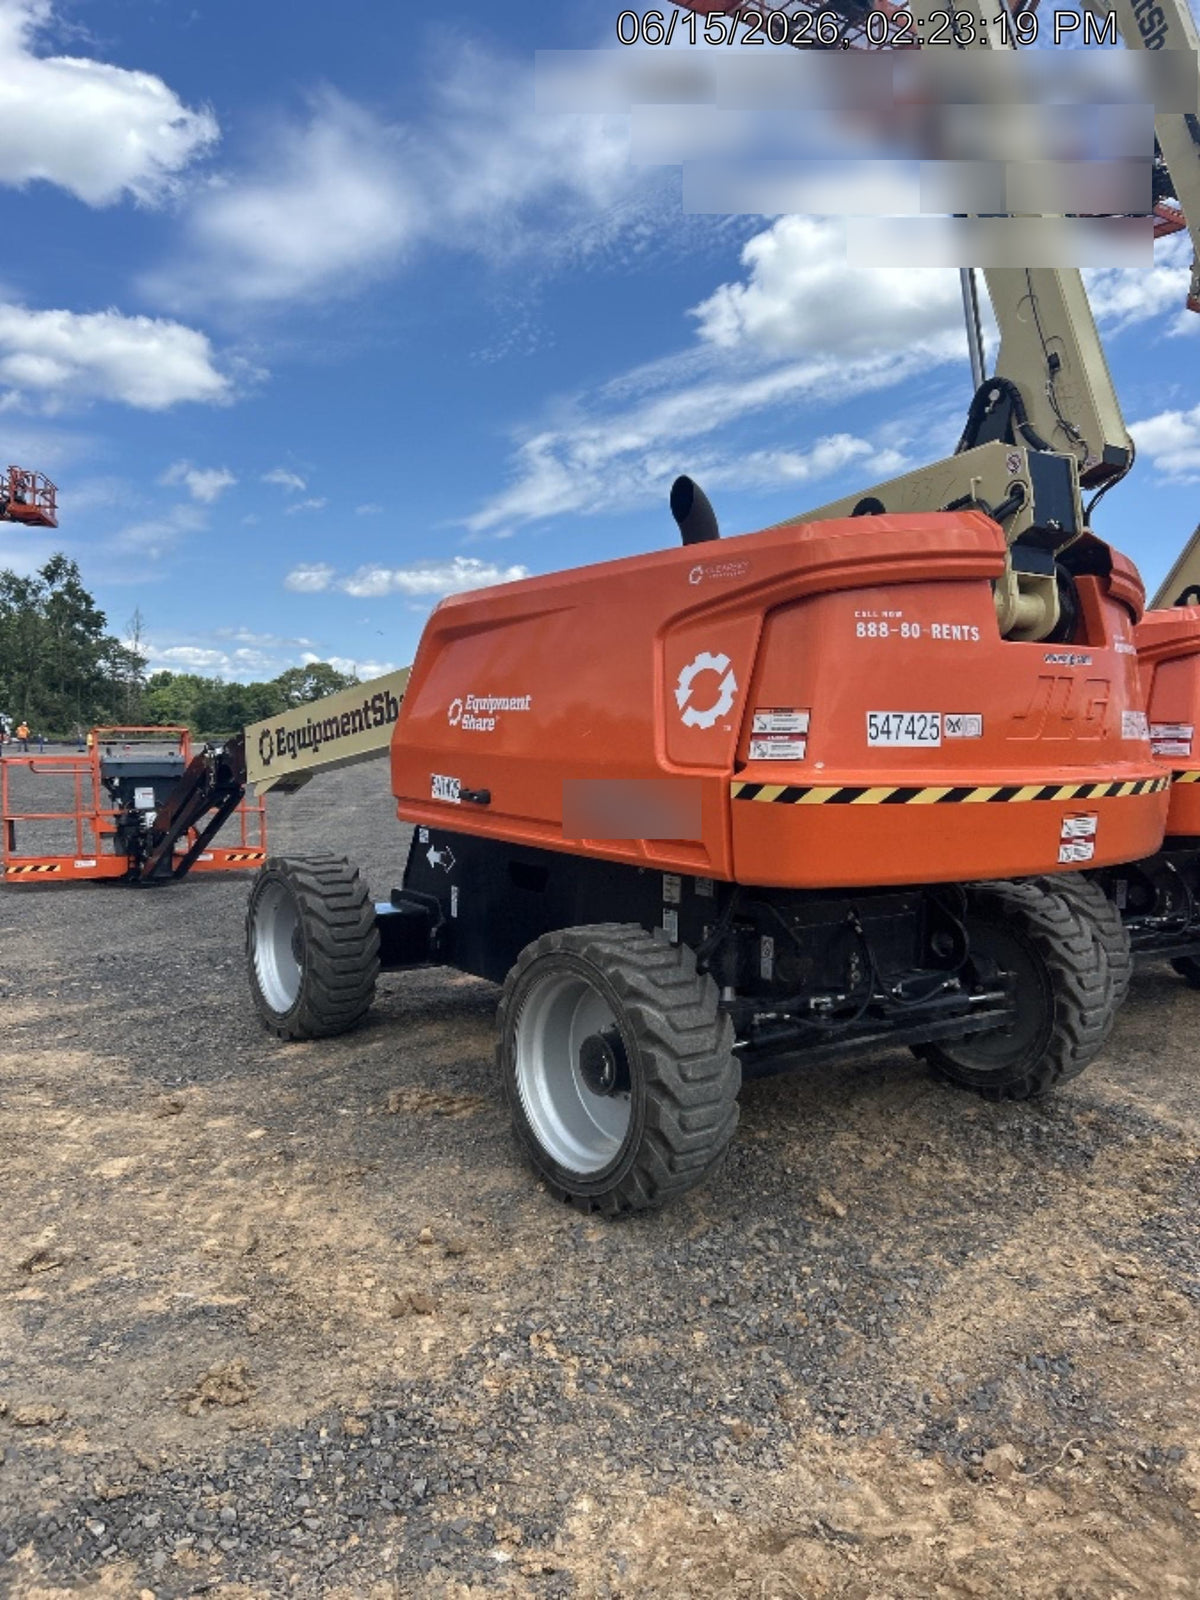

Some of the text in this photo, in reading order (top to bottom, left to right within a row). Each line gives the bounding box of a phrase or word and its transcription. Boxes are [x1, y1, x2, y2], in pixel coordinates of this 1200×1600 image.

[881, 611, 903, 619] NOW
[465, 694, 532, 714] Equipment
[1005, 675, 1111, 741] JLG
[461, 714, 495, 732] Share
[868, 714, 941, 741] 547425
